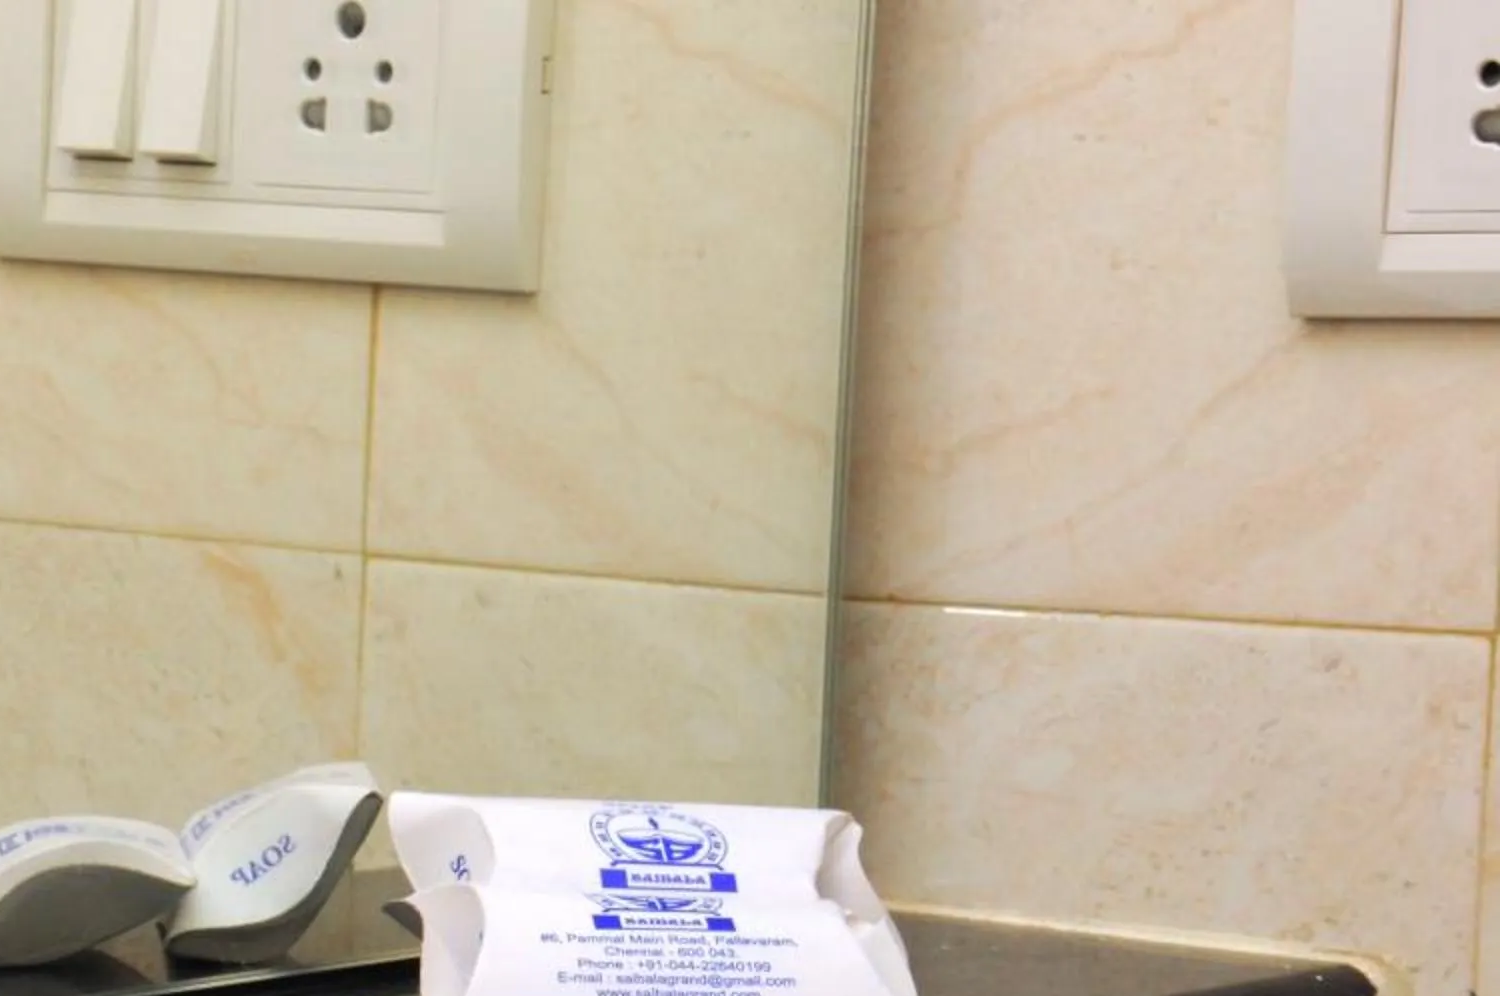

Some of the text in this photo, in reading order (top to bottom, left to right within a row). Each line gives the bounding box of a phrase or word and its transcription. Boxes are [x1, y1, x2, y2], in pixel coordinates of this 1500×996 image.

[629, 934, 665, 944] Main
[668, 935, 711, 946] Road,
[604, 946, 664, 957] Chennai
[577, 957, 624, 969] Phone
[557, 971, 603, 984] E-mail
